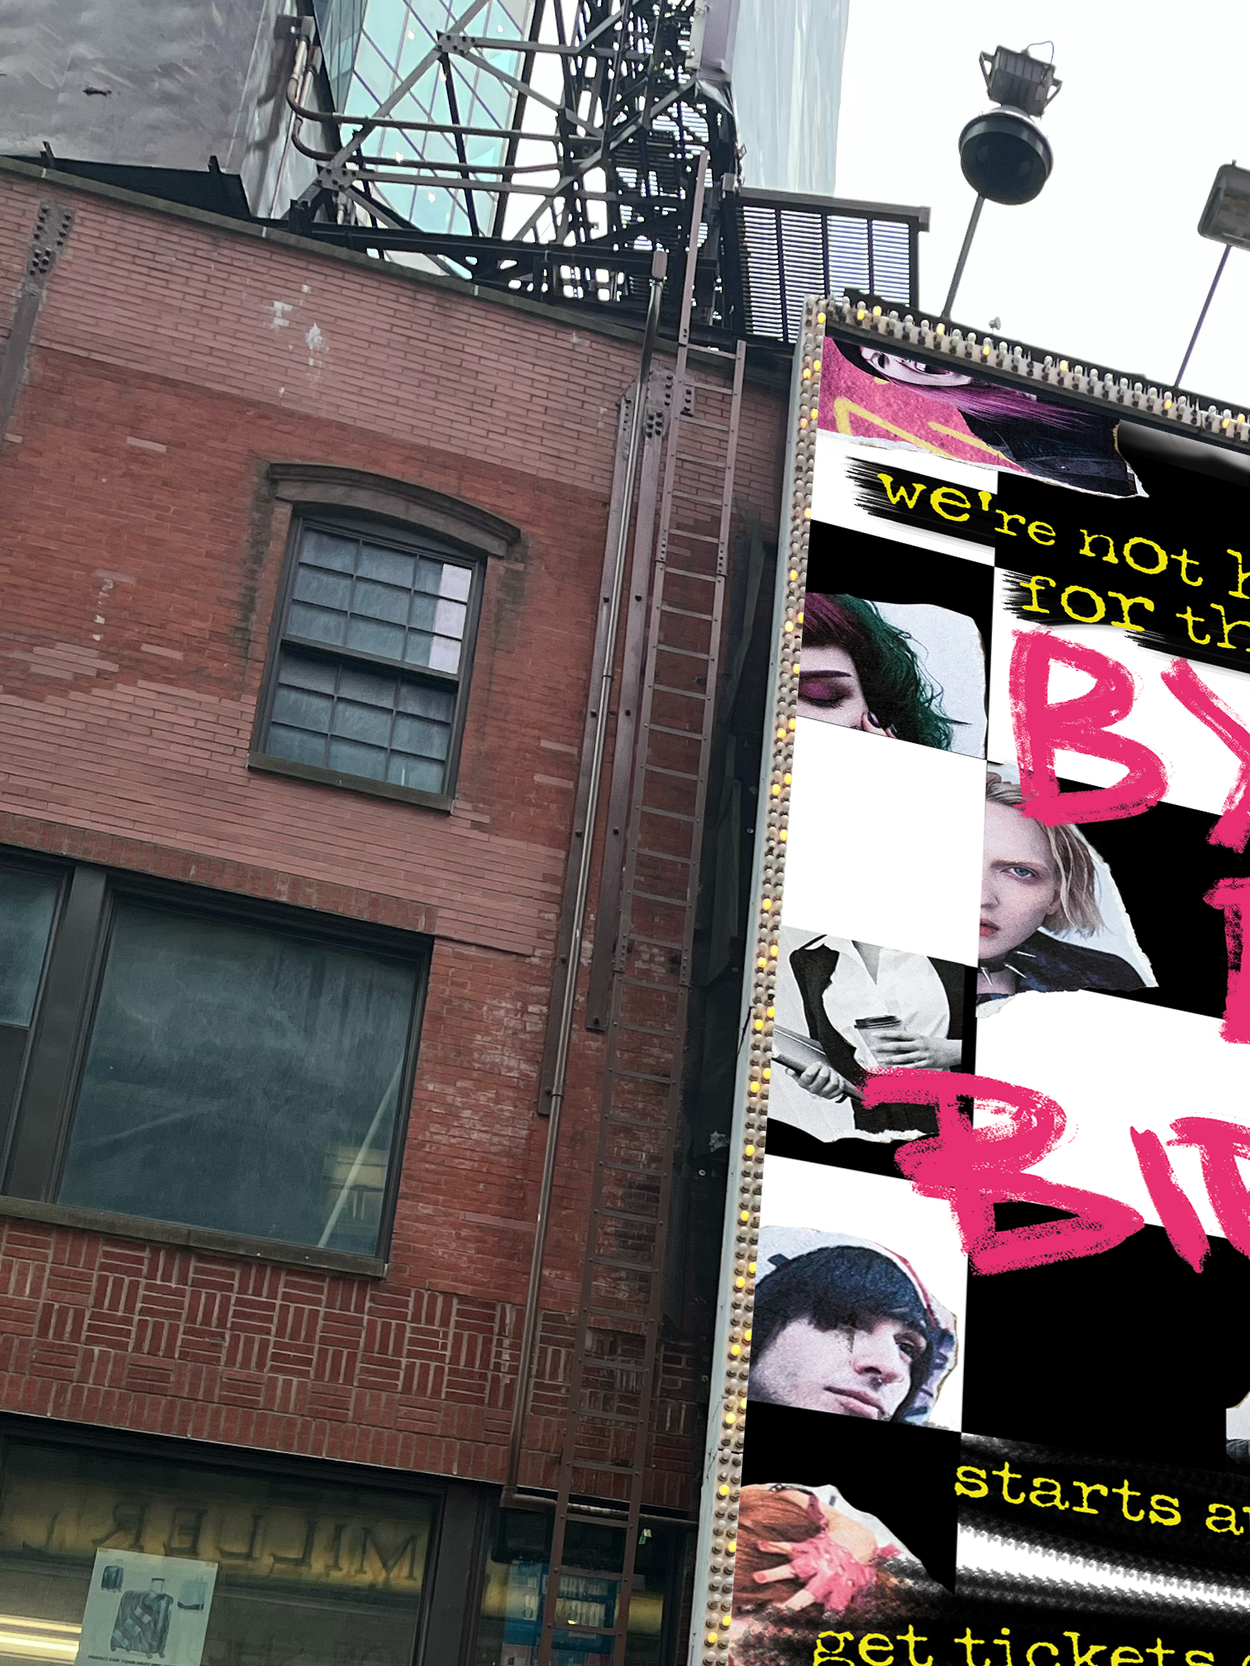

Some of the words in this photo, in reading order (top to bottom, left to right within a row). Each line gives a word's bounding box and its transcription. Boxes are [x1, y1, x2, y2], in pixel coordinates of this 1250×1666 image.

[876, 470, 1057, 547] we're
[1078, 528, 1205, 588] not
[1018, 574, 1156, 633] for
[953, 1460, 1183, 1527] starts
